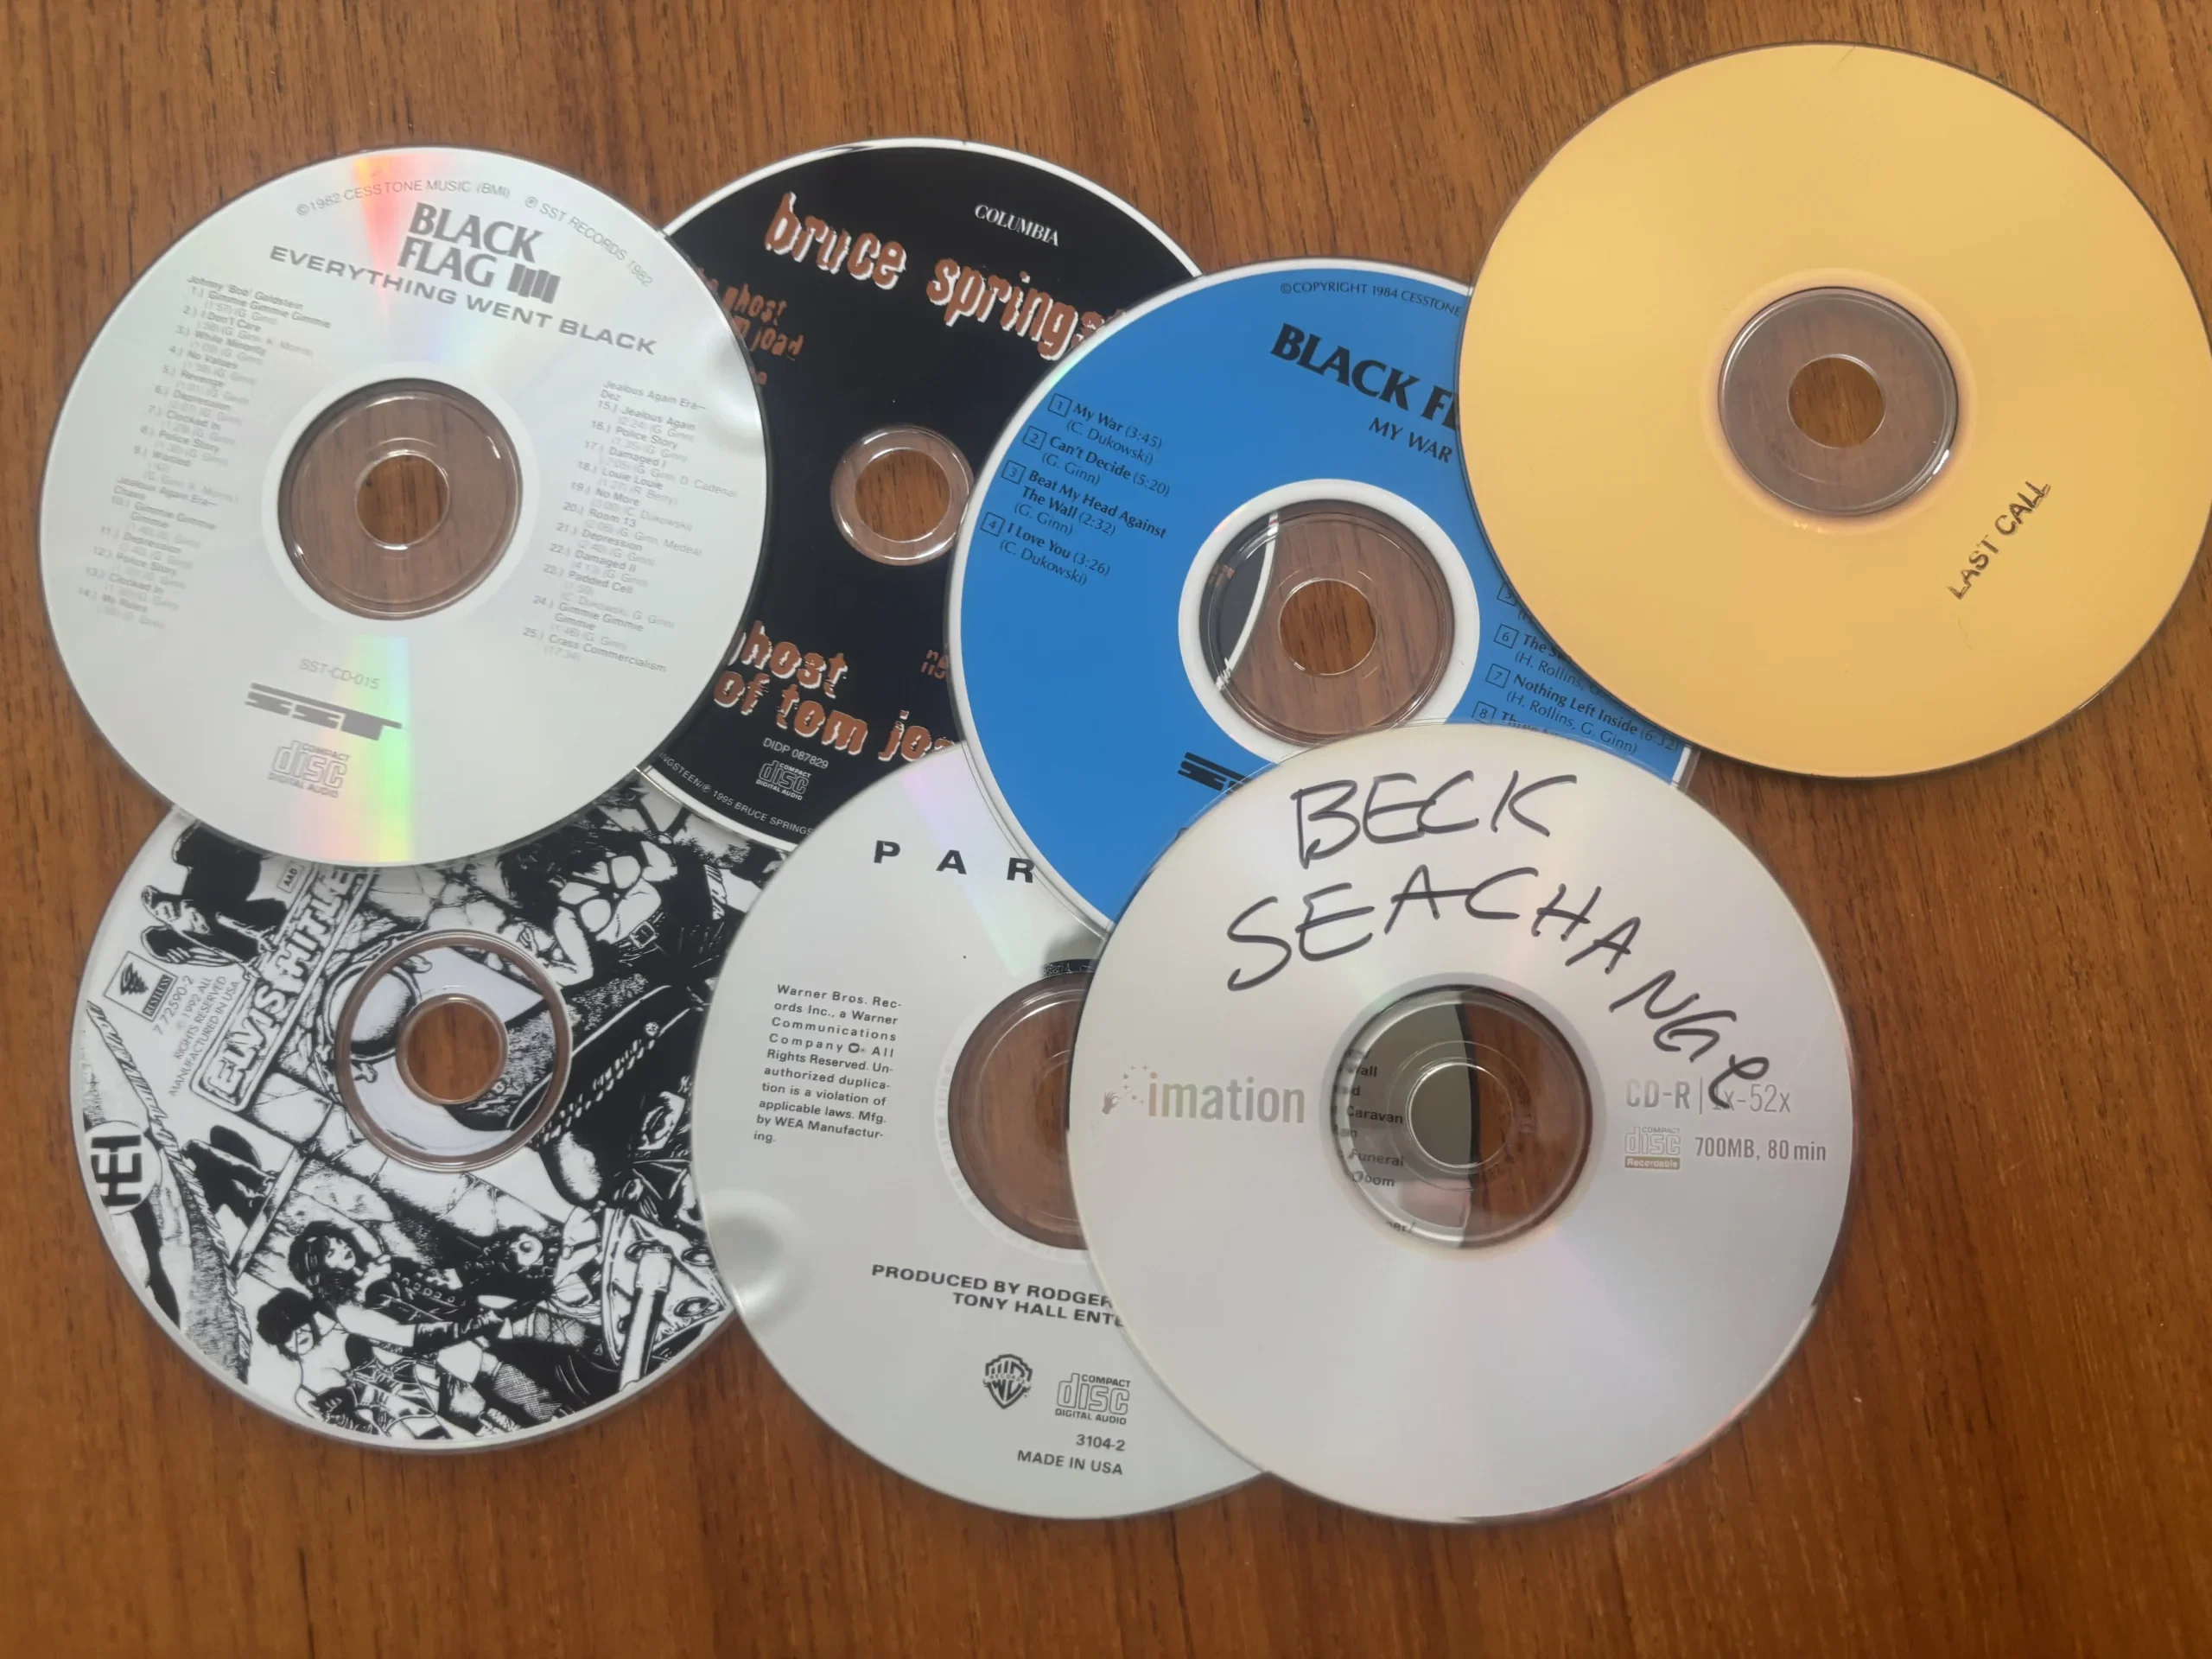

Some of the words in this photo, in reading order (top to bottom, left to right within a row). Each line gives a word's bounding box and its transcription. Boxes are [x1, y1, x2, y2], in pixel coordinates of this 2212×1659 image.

[408, 202, 543, 263] BLACK
[427, 181, 471, 193] MUSIC
[477, 181, 510, 199] (BMI)
[540, 204, 567, 222] SST
[569, 217, 627, 261] RECORDS
[626, 259, 653, 288] 1982
[975, 204, 1059, 246] COLUMBIA
[397, 237, 497, 289] FLAG
[765, 191, 906, 290] bruce
[926, 257, 1126, 361] springs
[270, 245, 457, 305] EVERYTHING
[467, 295, 552, 329] WENT
[558, 319, 658, 355] BLACK
[1372, 285, 1398, 298] 1984
[1402, 290, 1462, 317] CESSTONE
[1270, 322, 1421, 411] BLACK
[601, 389, 621, 402] Dez
[603, 380, 644, 397] Jealous
[647, 391, 677, 404] Again
[1072, 404, 1094, 420] My
[1097, 412, 1123, 432] War
[1125, 425, 1162, 450] (3:45)
[1369, 417, 1403, 441] MY
[1408, 432, 1452, 463] WAR
[651, 435, 678, 450] Story
[1087, 428, 1154, 466] Dukowski)
[1065, 461, 1101, 486] Ginn)
[1085, 451, 1131, 480] Decide
[1133, 472, 1170, 497] (5:20)
[595, 488, 610, 499] No
[613, 492, 639, 506] More
[1022, 486, 1046, 505] The
[1049, 497, 1077, 518] Wall
[1078, 512, 1116, 536] (2:32)
[1028, 470, 1058, 492] Beat
[1059, 484, 1081, 500] My
[1082, 494, 1118, 518] Head
[1118, 511, 1166, 539] Against
[1037, 512, 1073, 536] Ginn)
[1015, 524, 1045, 547] Love
[1047, 539, 1071, 559] You
[1073, 551, 1110, 576] (3:26)
[1947, 534, 1999, 600] LAST
[1994, 481, 2051, 536] CALL
[1020, 547, 1087, 586] Dukowski)
[1522, 633, 1547, 652] The
[299, 658, 380, 690] SST-CD-015
[1538, 660, 1584, 690] Rollins,
[714, 671, 771, 715] of
[776, 684, 868, 755] tom
[1513, 674, 1567, 708] Nothing
[1570, 697, 1596, 718] Left
[1599, 709, 1637, 734] Inside
[1529, 701, 1576, 730] Rollins,
[1580, 721, 1594, 737] G.
[1599, 729, 1637, 754] Ginn)
[763, 737, 791, 754] DIDP
[791, 749, 829, 770] 087829
[759, 760, 810, 795] disc
[779, 762, 811, 778] COMPACT
[755, 779, 781, 792] DIGITAL
[781, 789, 803, 801] AUDIO
[713, 791, 734, 806] 1995
[734, 802, 768, 821] BRUCE
[1291, 769, 1578, 870] BECK
[283, 866, 299, 888] AAD
[144, 976, 171, 1016] RESTLESS
[194, 976, 226, 1023] RESERVED
[198, 978, 213, 993] ALL
[222, 982, 239, 1001] USA
[778, 984, 827, 1000] Warner
[832, 991, 868, 1004] Bros.
[873, 996, 902, 1008] Rec-
[772, 1016, 896, 1042] Communications
[774, 1002, 803, 1014] ords
[852, 1009, 899, 1026] Warner
[769, 1033, 843, 1053] Company
[871, 1046, 893, 1058] All
[767, 1048, 806, 1063] Rights
[810, 1054, 868, 1071] Reserved.
[873, 1062, 893, 1074] Un-
[764, 1067, 835, 1084] authorized
[839, 1075, 890, 1090] duplica-
[761, 1083, 785, 1094] tion
[790, 1085, 799, 1096] is
[817, 1090, 868, 1104] violation
[873, 1096, 887, 1107] of
[1147, 1071, 1305, 1123] imation
[1625, 1079, 1690, 1109] CD-R
[757, 1114, 771, 1126] by
[775, 1116, 804, 1128] WEA
[808, 1120, 883, 1139] Manufactur-
[759, 1099, 821, 1116] applicable
[825, 1107, 855, 1119] laws.
[858, 1110, 887, 1125] Mfg.
[1347, 1105, 1403, 1123] Caravan
[753, 1130, 776, 1144] ing.
[1624, 1126, 1681, 1155] disc
[1695, 1137, 1760, 1161] 700MB,
[1768, 1140, 1789, 1160] 80
[1793, 1141, 1827, 1161] min
[1627, 1158, 1678, 1168] Recordable
[872, 1263, 988, 1291] PRODUCED
[994, 1280, 1020, 1294] BY
[1027, 1284, 1113, 1309] RODGER
[952, 1291, 1008, 1311] TONY
[1014, 1300, 1067, 1319] HALL
[1056, 1372, 1130, 1415] disc
[1081, 1374, 1131, 1388] COMPACT
[1055, 1408, 1092, 1421] DIGITAL
[1095, 1414, 1127, 1426] AUDIO
[1076, 1433, 1126, 1452] 3104-2
[1017, 1449, 1064, 1467] MADE
[1069, 1457, 1085, 1471] IN
[1090, 1459, 1123, 1476] USA
